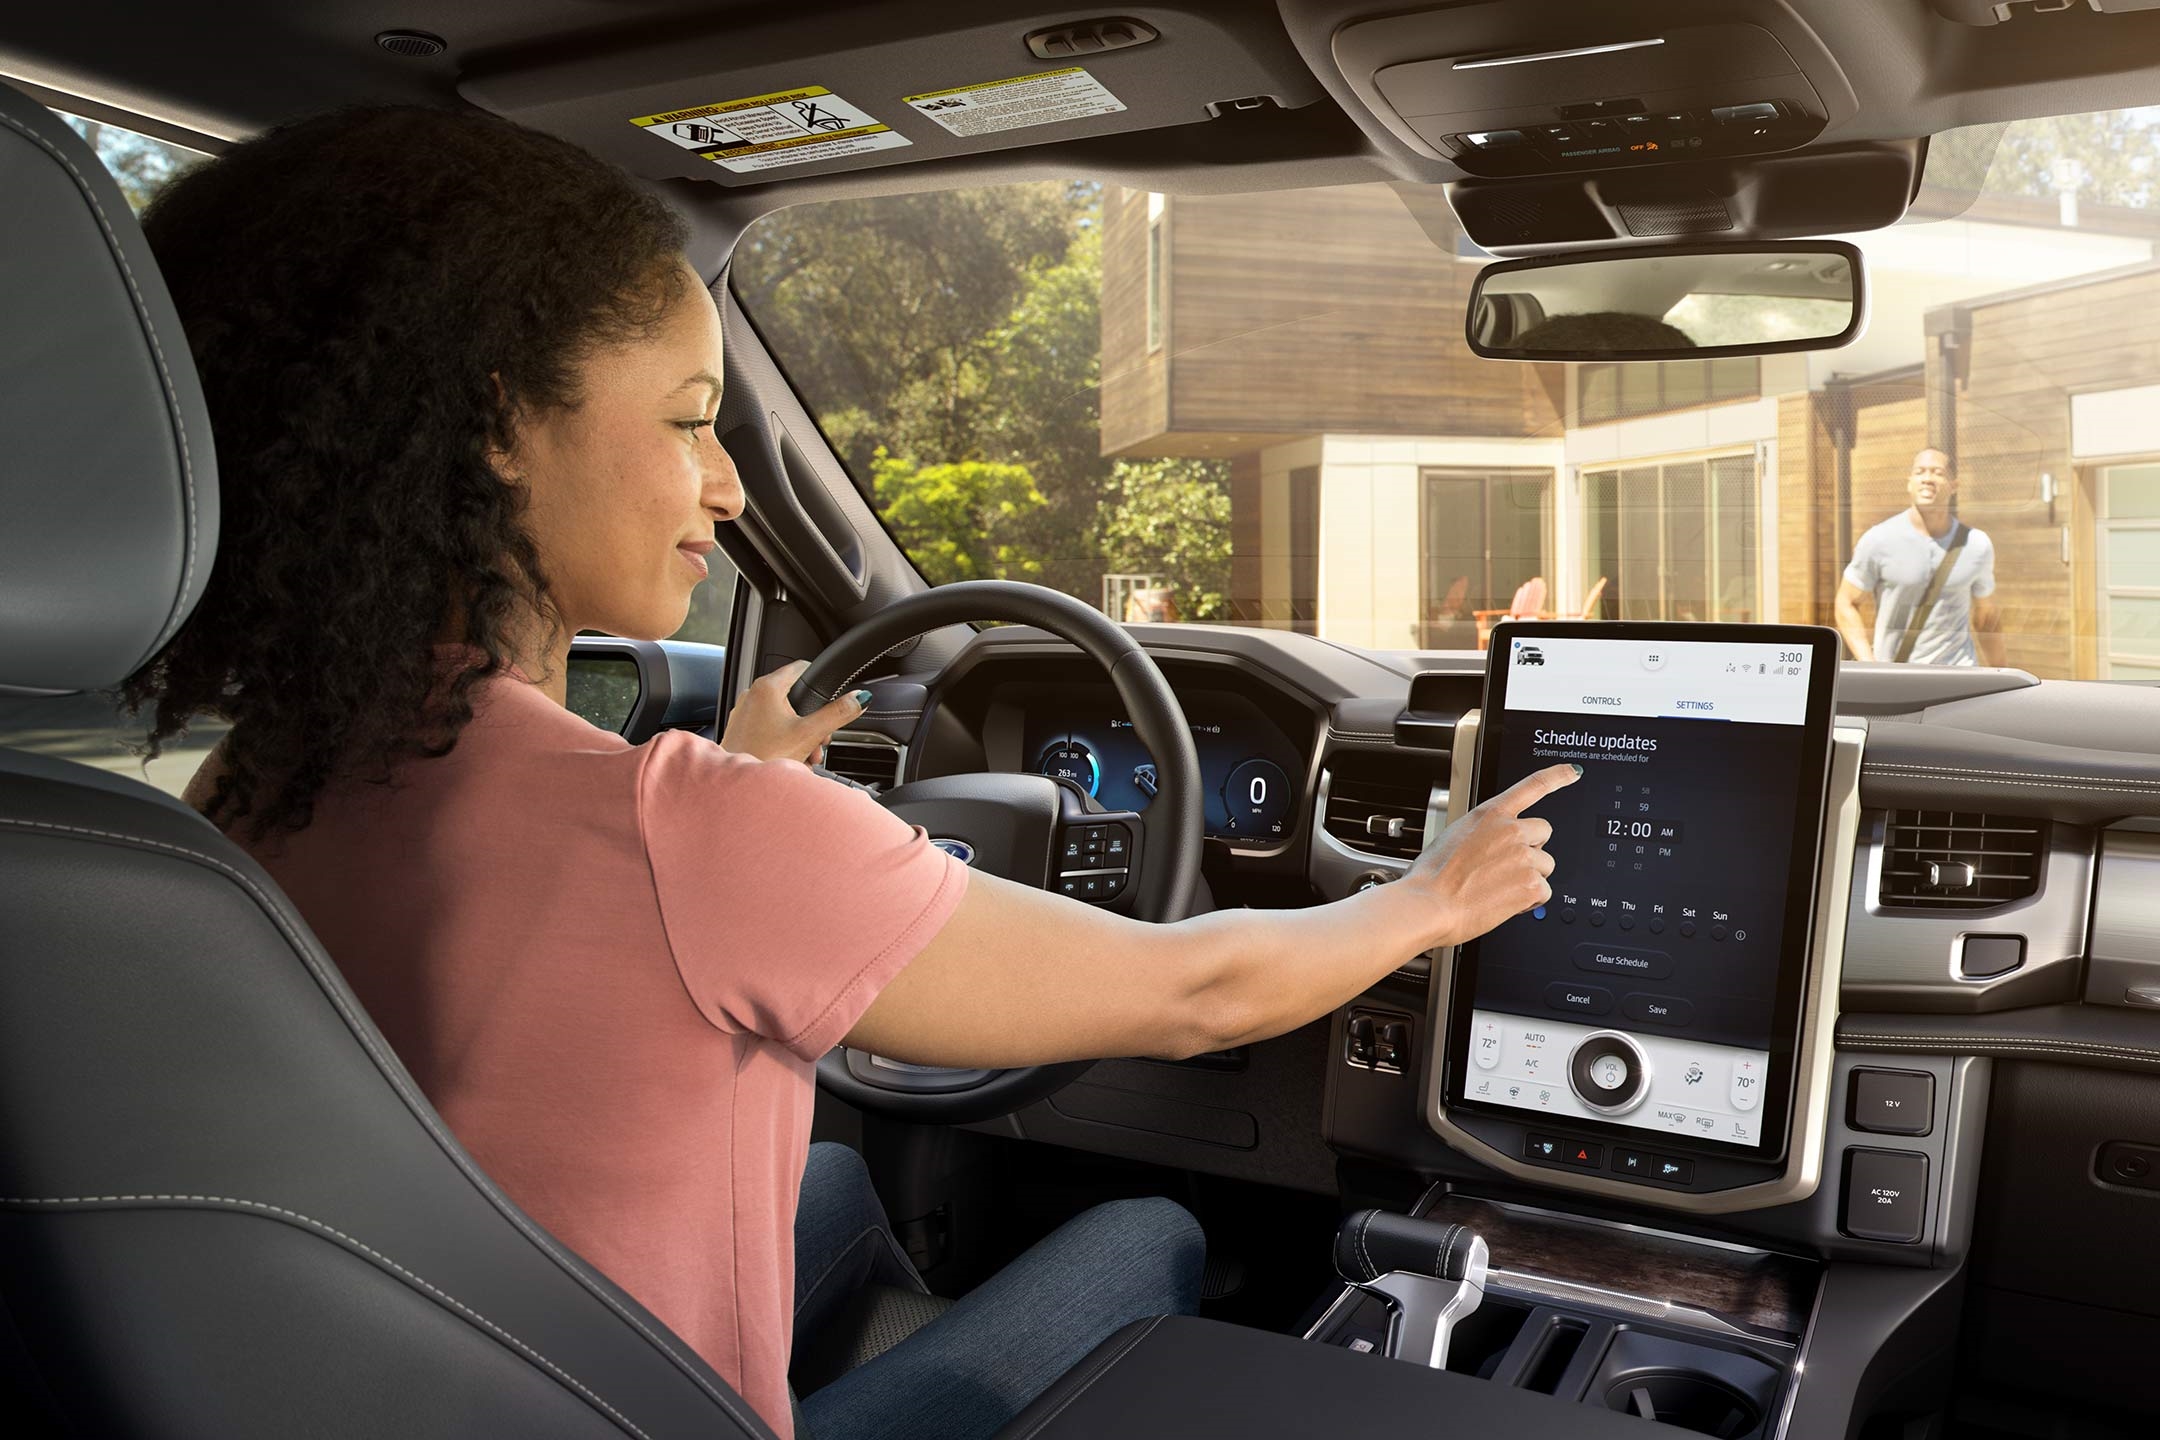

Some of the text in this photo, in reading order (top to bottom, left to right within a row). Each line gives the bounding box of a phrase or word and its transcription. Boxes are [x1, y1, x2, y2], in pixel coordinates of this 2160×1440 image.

[1561, 149, 1597, 157] PASSENGER
[1779, 652, 1803, 663] 3:00
[1582, 696, 1714, 711] CONTROLS SETTINGS
[1534, 729, 1657, 751] Schedule updates
[1533, 748, 1559, 758] System
[1559, 751, 1588, 760] updates
[1601, 752, 1637, 763] scheduled
[1638, 755, 1649, 763] for
[1058, 768, 1071, 778] 263
[1250, 776, 1267, 805] 0
[1614, 801, 1650, 812] 11 59
[1231, 821, 1236, 829] 0
[1660, 828, 1674, 837] AM
[1608, 843, 1672, 857] 01 01 PM
[1563, 895, 1728, 921] Tue Wed Thu Fri Sat Sun
[1596, 953, 1649, 969] Clear Schedule
[1566, 993, 1591, 1005] Cancel
[1648, 1004, 1668, 1015] Save
[1524, 1032, 1546, 1043] AUTO
[1482, 1038, 1497, 1049] 72°
[1525, 1058, 1539, 1068] A/C
[1605, 1063, 1618, 1071] VOL
[1736, 1076, 1756, 1088] 70°
[1885, 1100, 1894, 1108] 12
[1657, 1111, 1673, 1119] MAX
[1871, 1188, 1900, 1198] AC 120V
[1877, 1196, 1893, 1205] 20A
